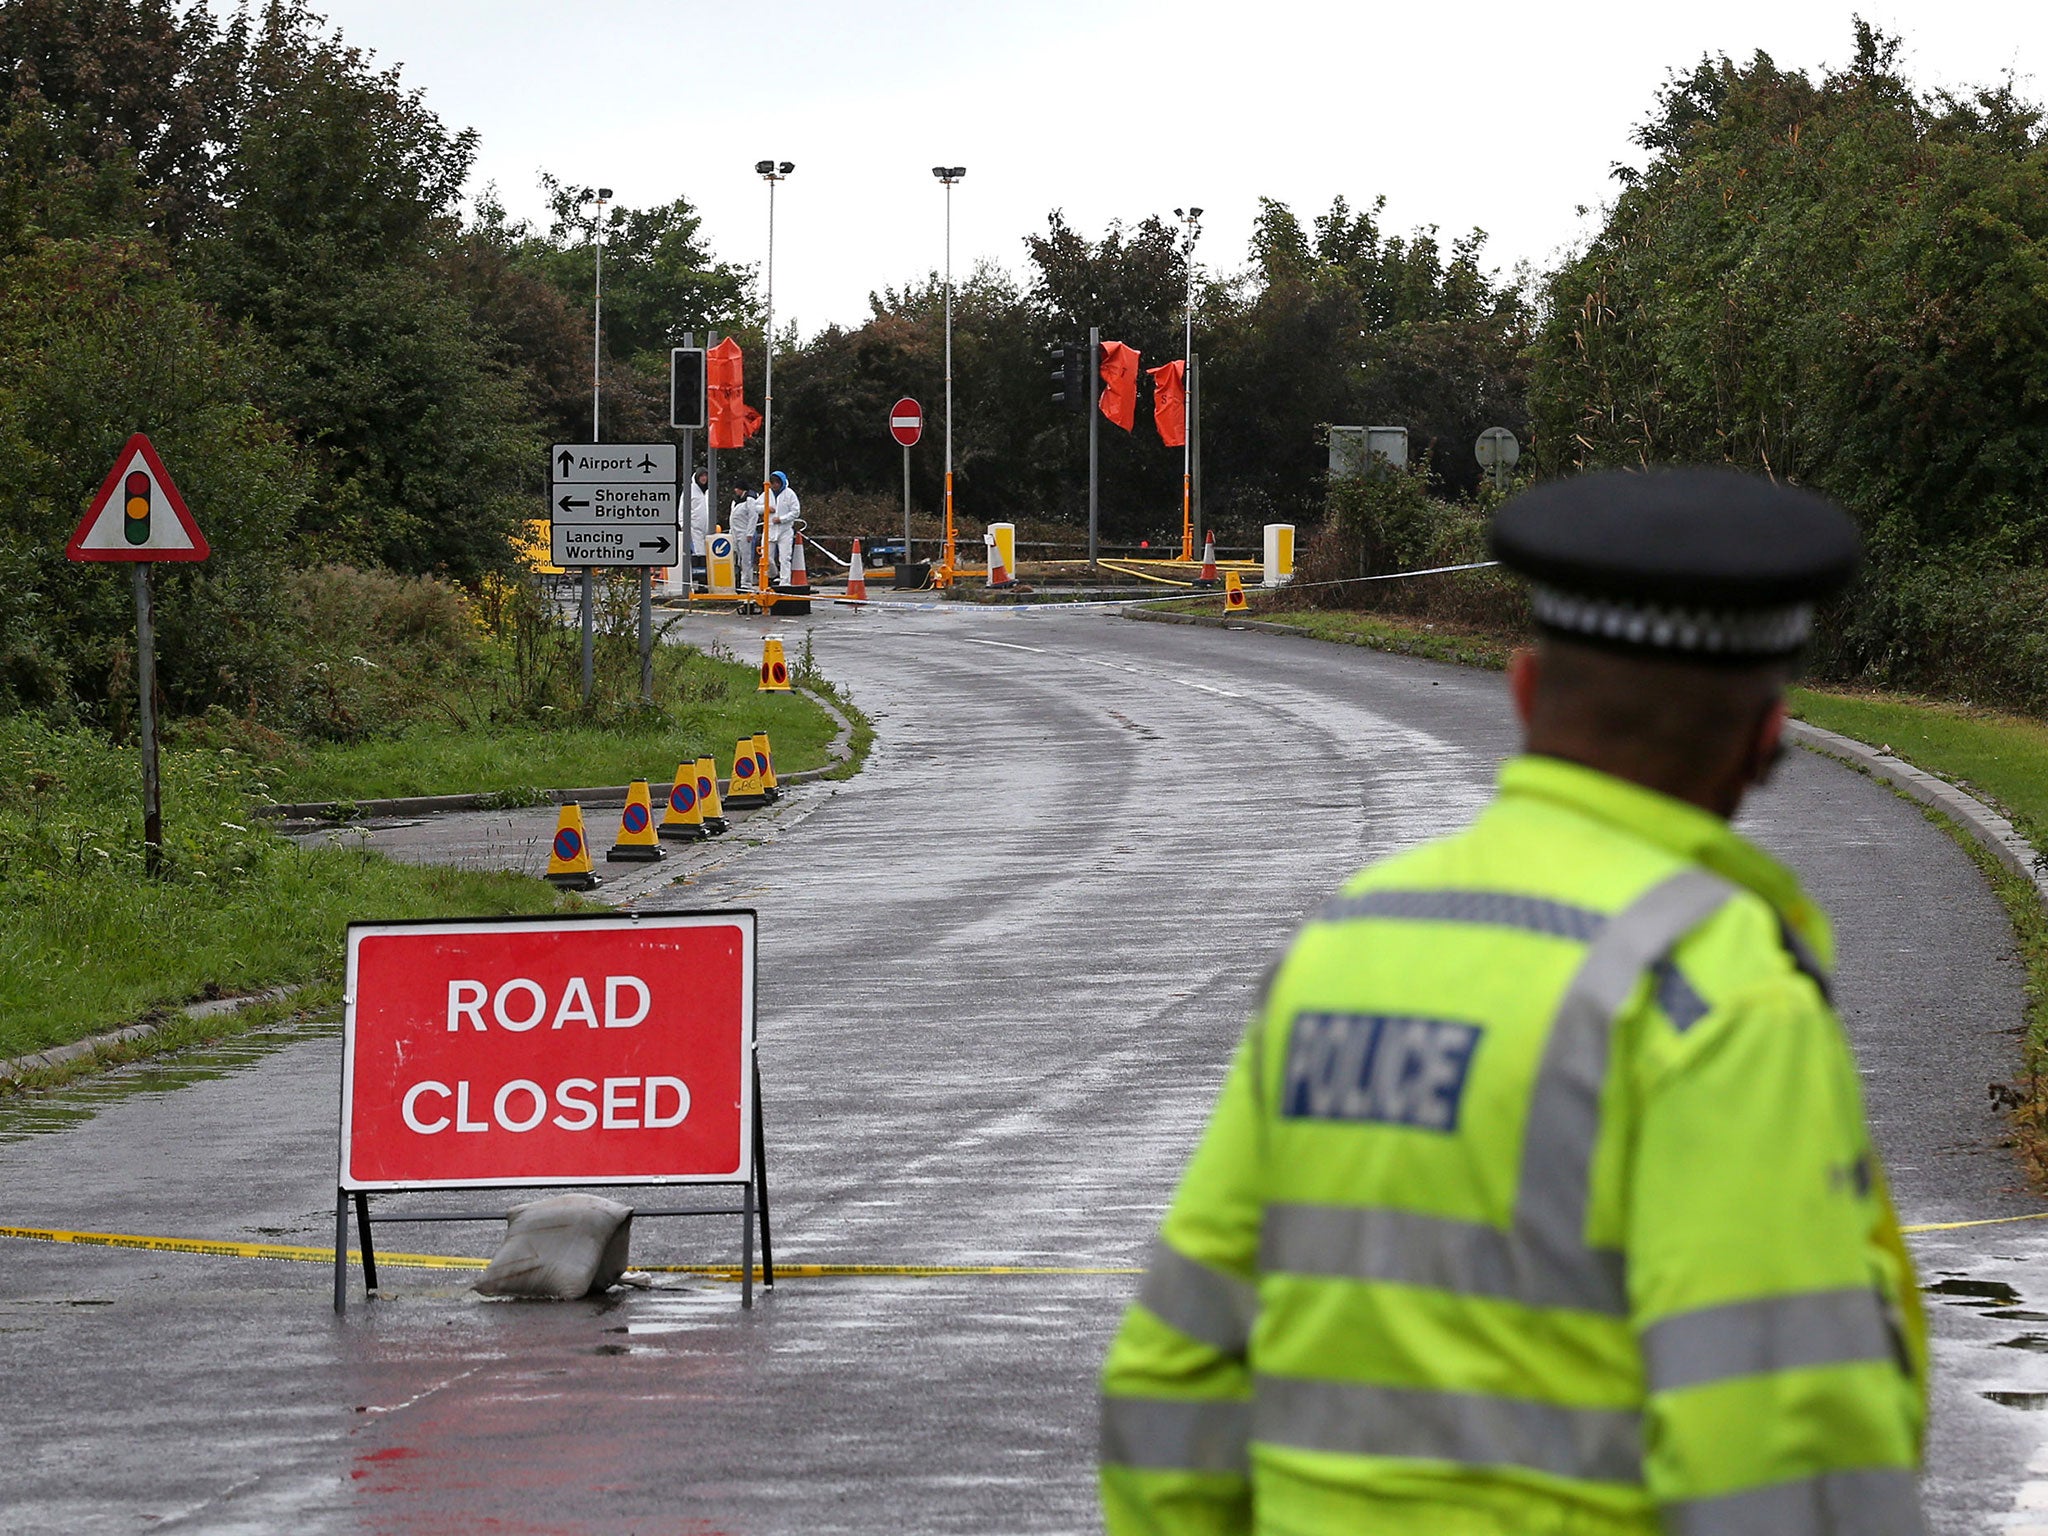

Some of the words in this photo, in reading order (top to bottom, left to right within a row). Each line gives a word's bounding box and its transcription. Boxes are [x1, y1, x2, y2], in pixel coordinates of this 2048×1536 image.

[579, 457, 632, 471] Airport
[595, 489, 670, 502] Shoreham
[595, 505, 660, 519] Brighton
[566, 531, 623, 545] Lancing
[566, 546, 634, 561] Worthing
[447, 976, 651, 1032] ROAD
[1285, 1014, 1468, 1126] POLICE
[402, 1076, 691, 1135] CLOSED
